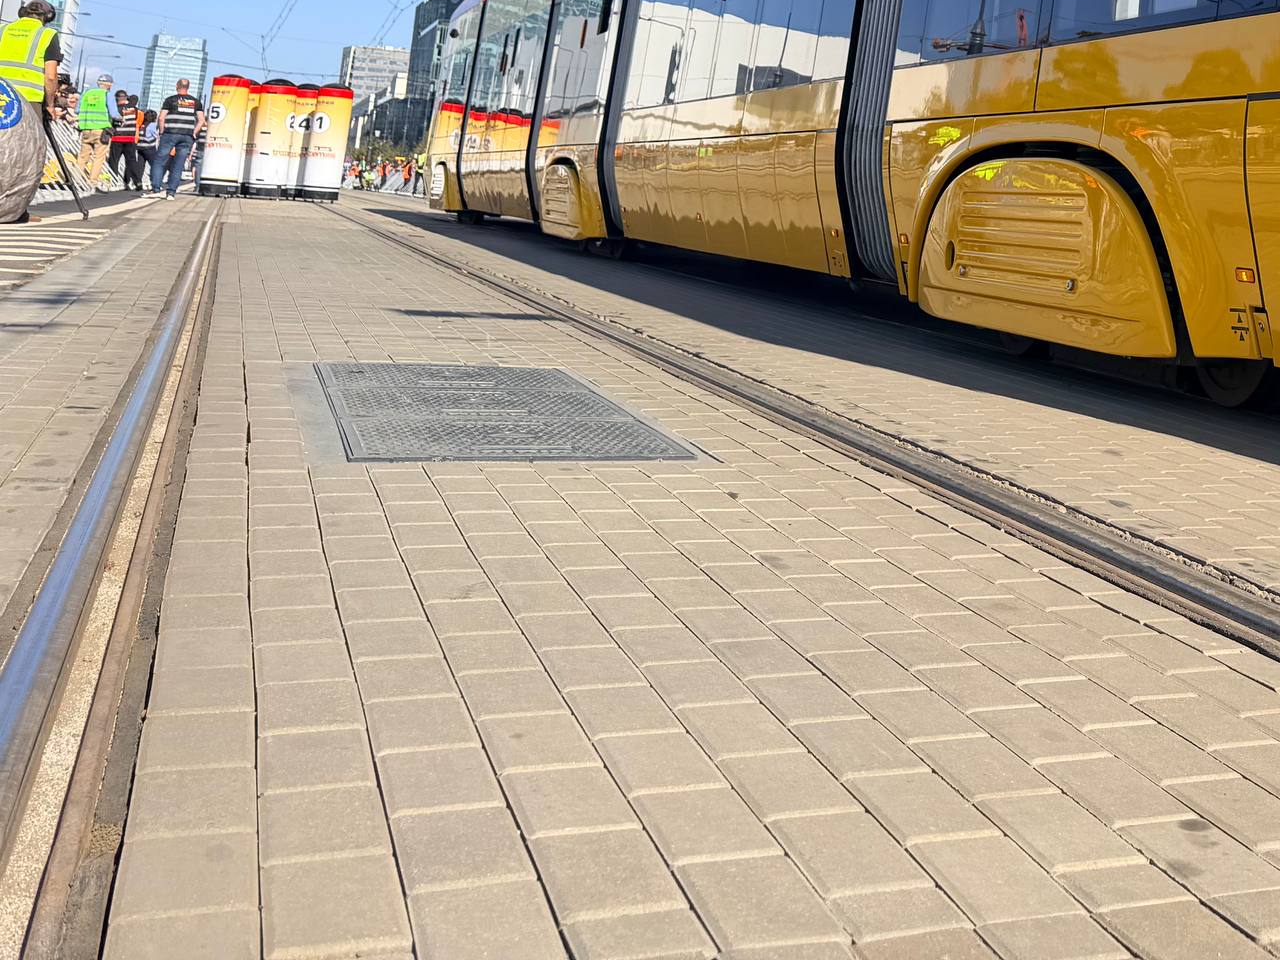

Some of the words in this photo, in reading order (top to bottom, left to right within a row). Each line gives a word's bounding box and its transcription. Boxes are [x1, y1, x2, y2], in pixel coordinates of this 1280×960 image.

[210, 106, 221, 119] 5
[298, 117, 311, 131] 4
[315, 116, 324, 129] 1
